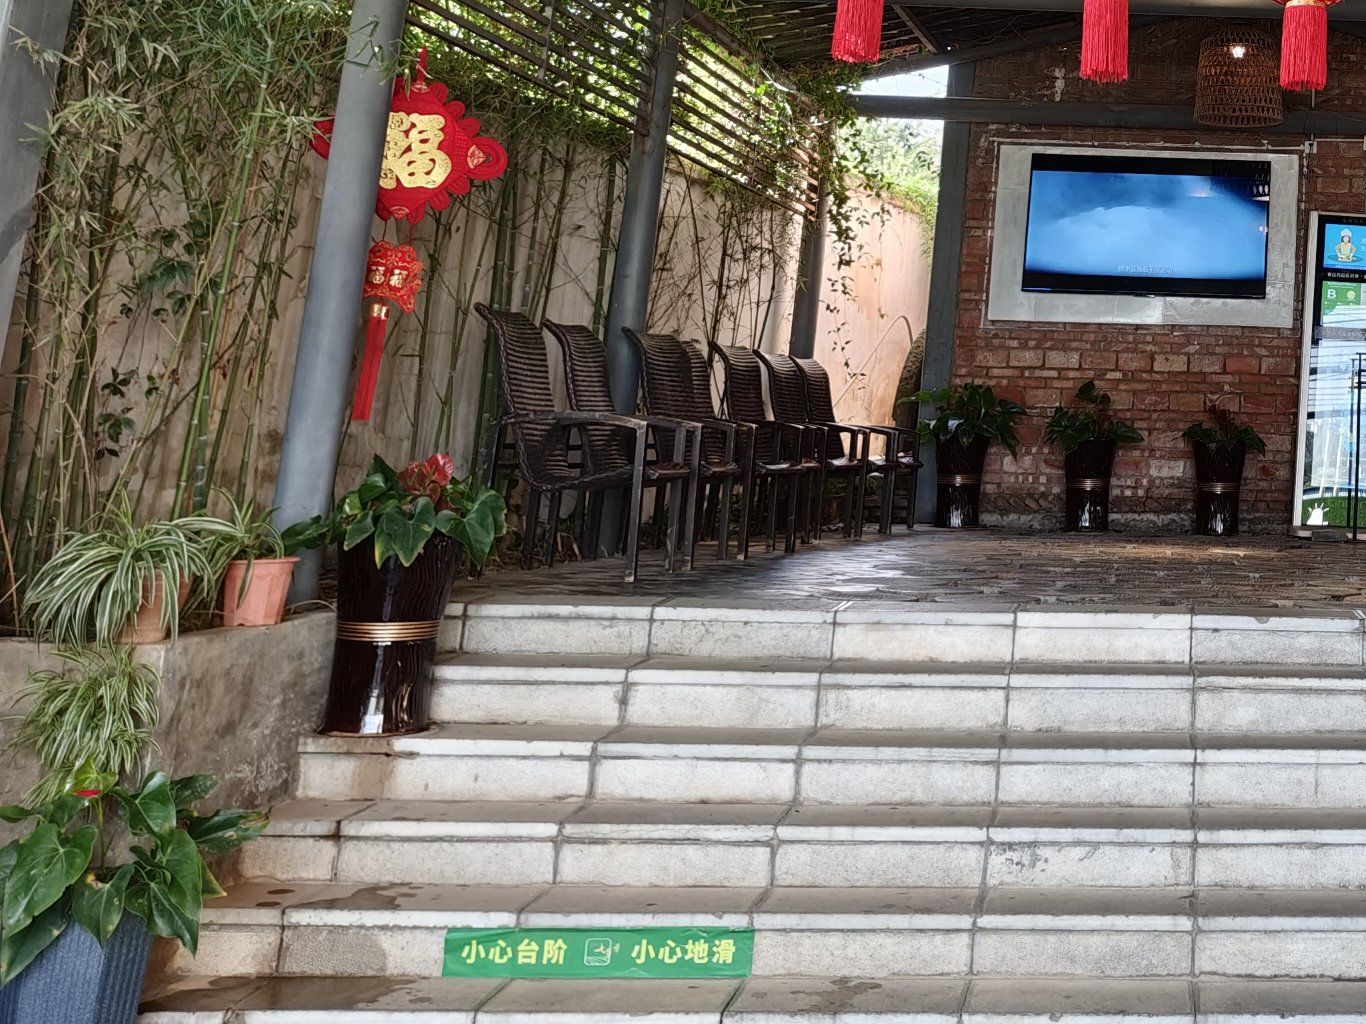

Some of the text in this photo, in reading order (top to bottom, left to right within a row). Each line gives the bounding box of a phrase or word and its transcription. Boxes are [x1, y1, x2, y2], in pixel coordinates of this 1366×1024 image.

[460, 938, 736, 966] 小心台阶 小心地滑
